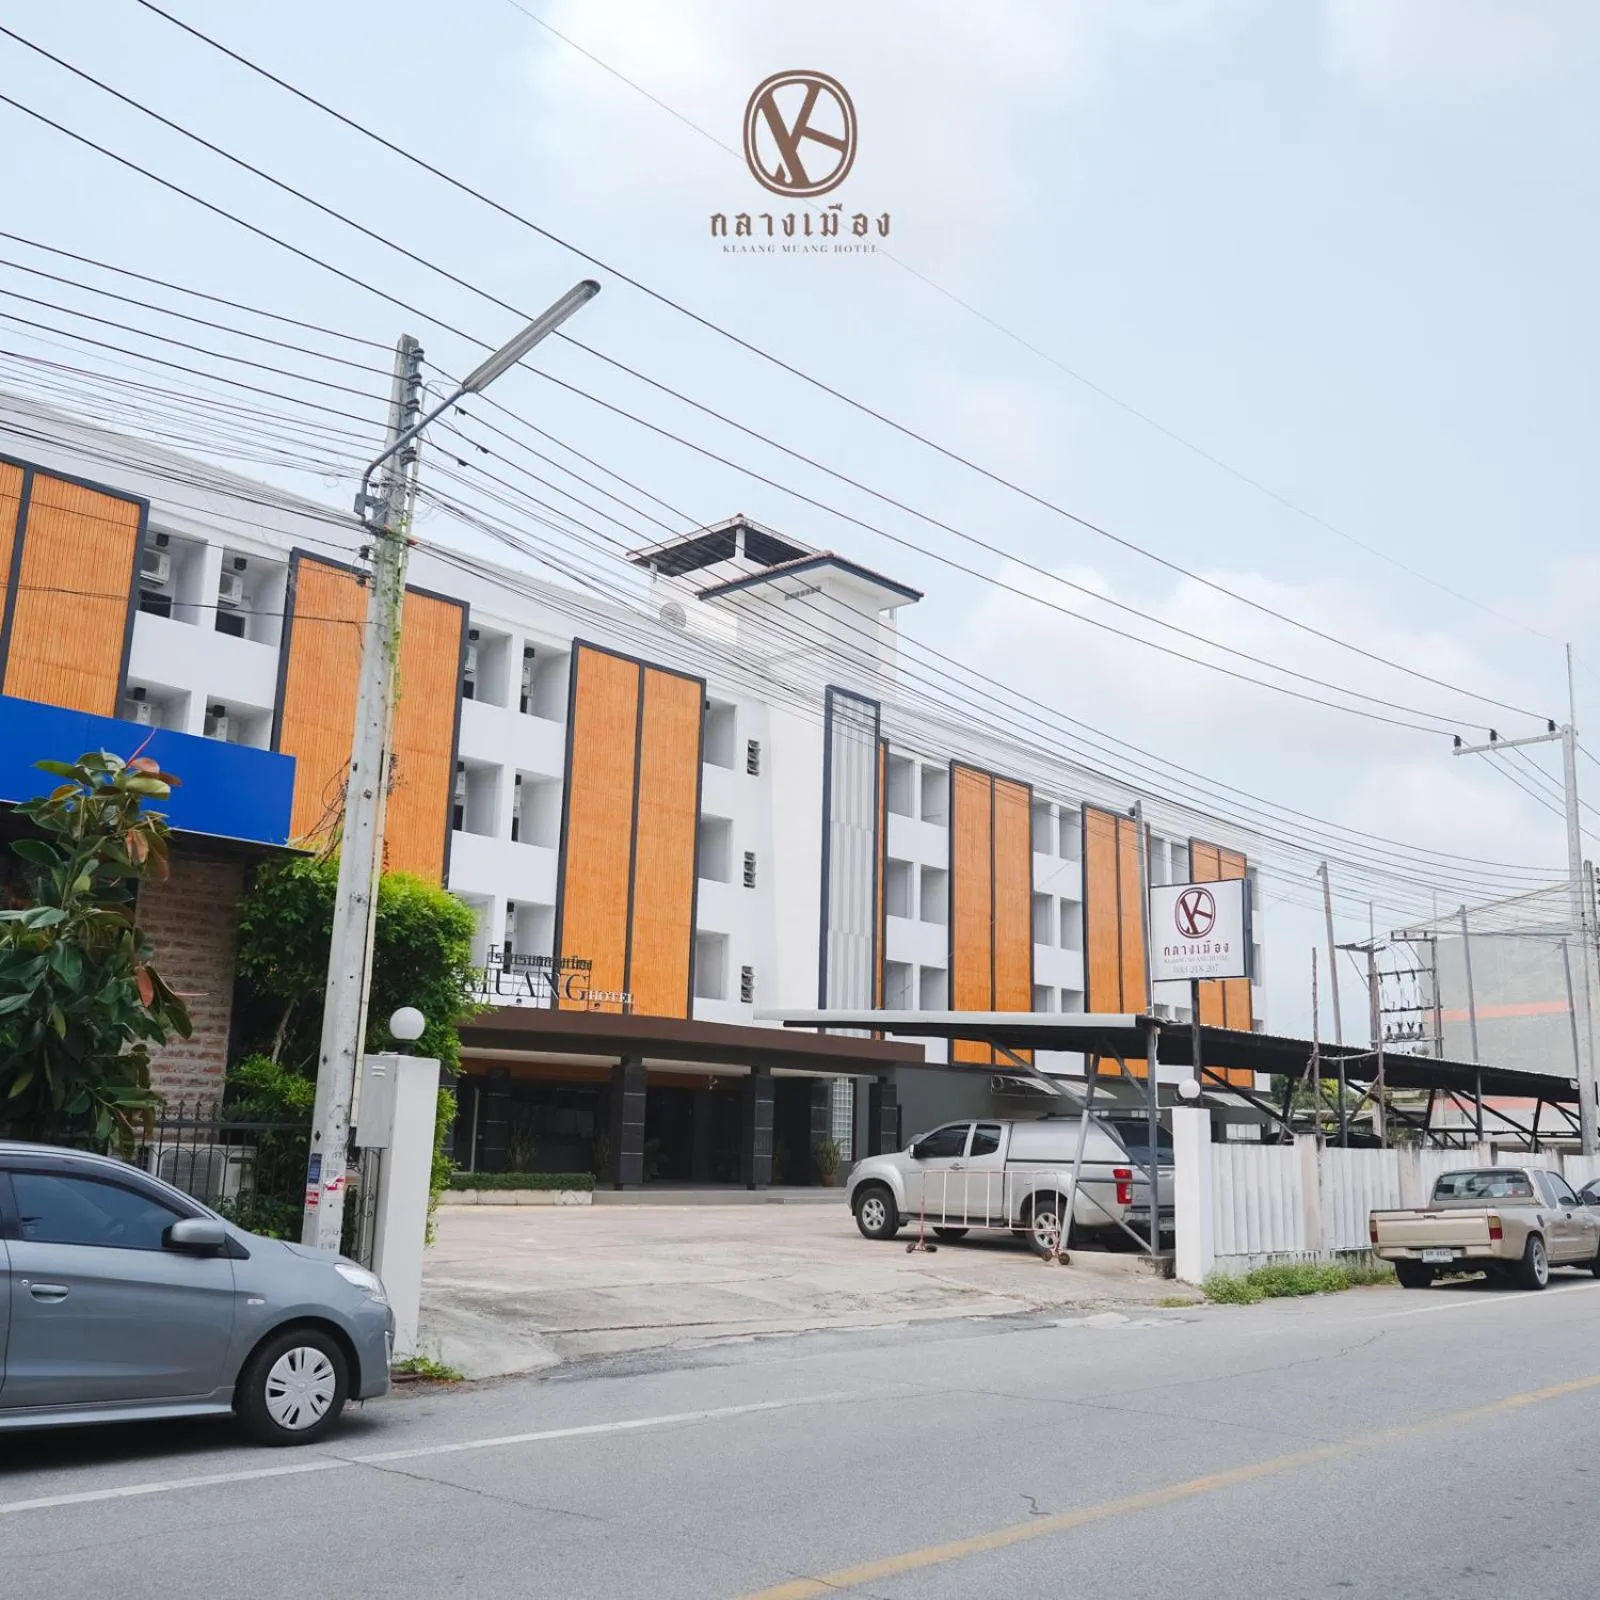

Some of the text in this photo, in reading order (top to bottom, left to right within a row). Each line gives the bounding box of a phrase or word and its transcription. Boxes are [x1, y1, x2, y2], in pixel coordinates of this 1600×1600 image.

[1164, 940, 1229, 956] กลางเมือง
[588, 989, 634, 1004] HOTEL
